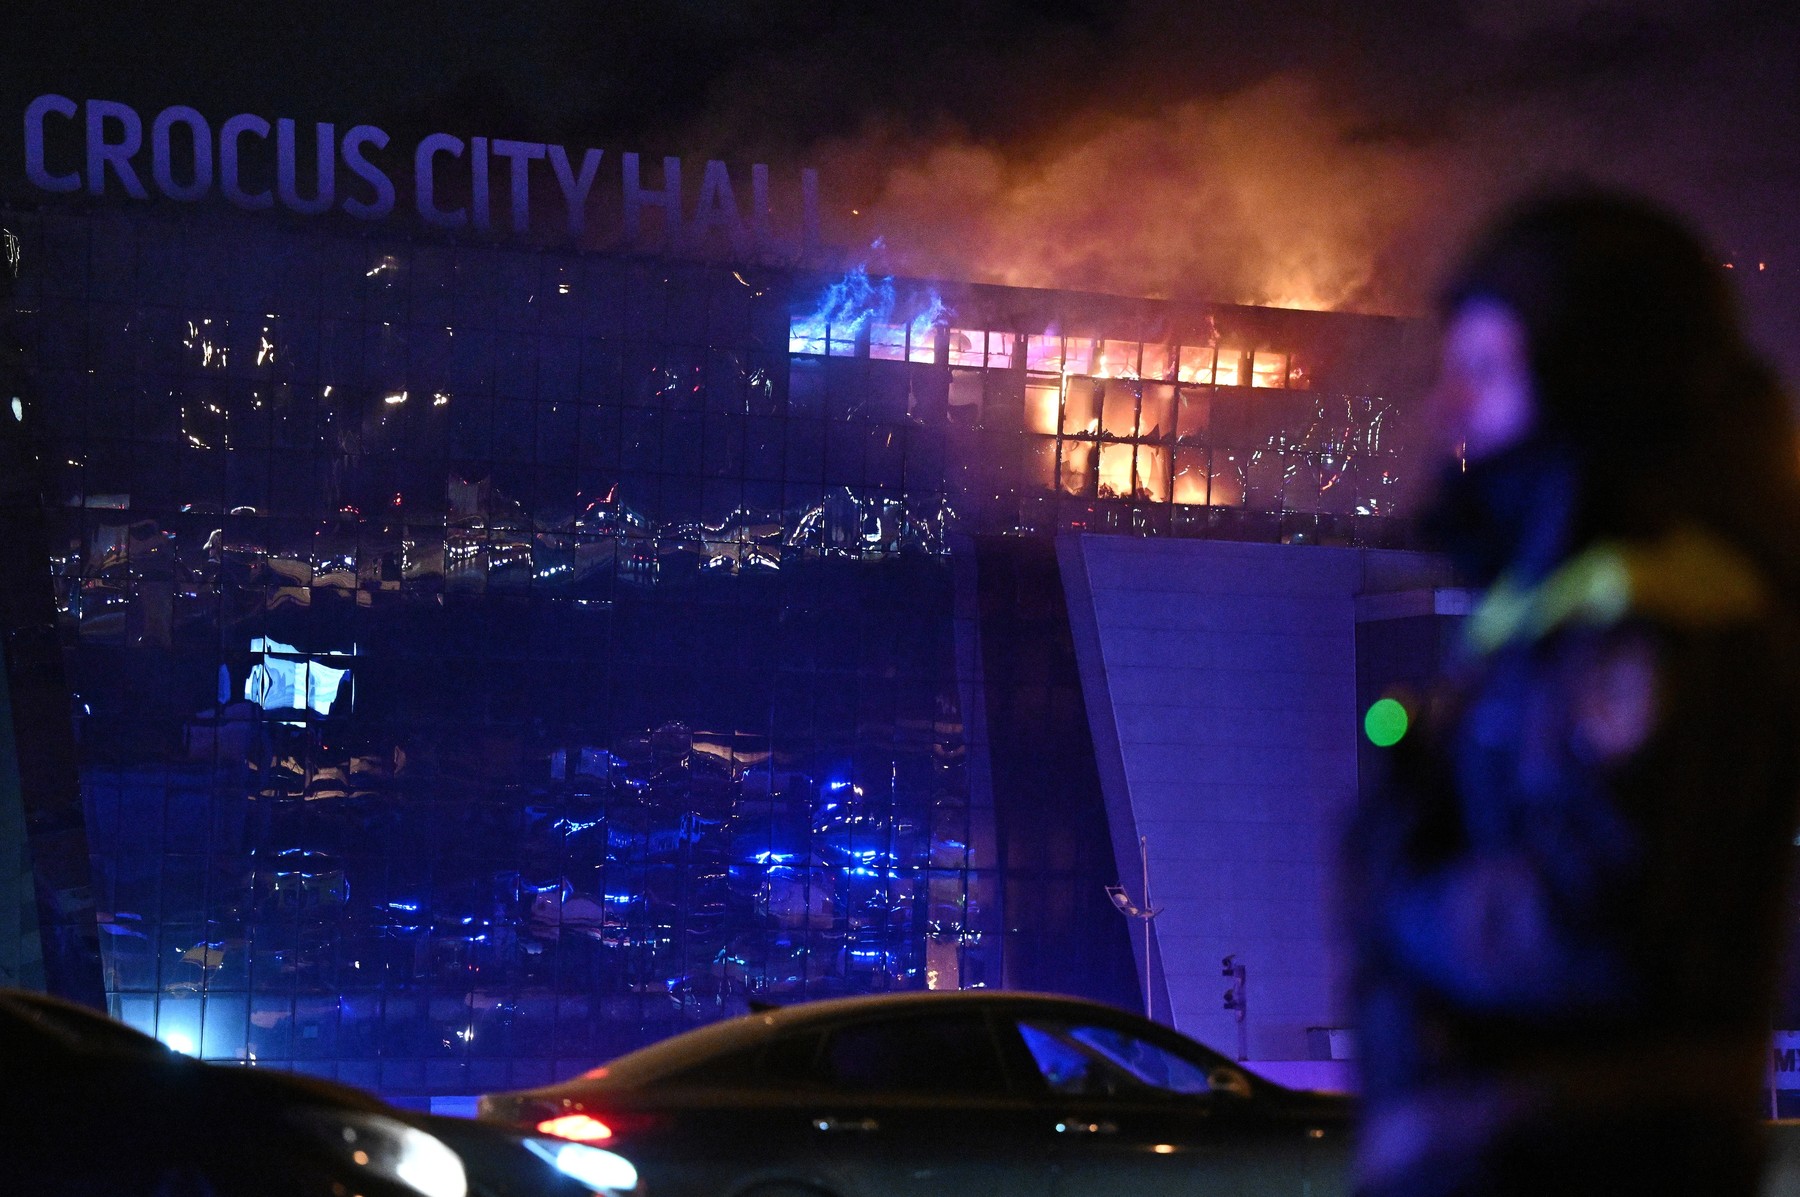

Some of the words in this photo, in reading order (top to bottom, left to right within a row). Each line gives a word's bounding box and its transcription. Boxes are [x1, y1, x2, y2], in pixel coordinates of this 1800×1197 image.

[24, 93, 396, 220] CROCUS
[414, 132, 604, 238] CITY
[622, 152, 838, 256] HALL
